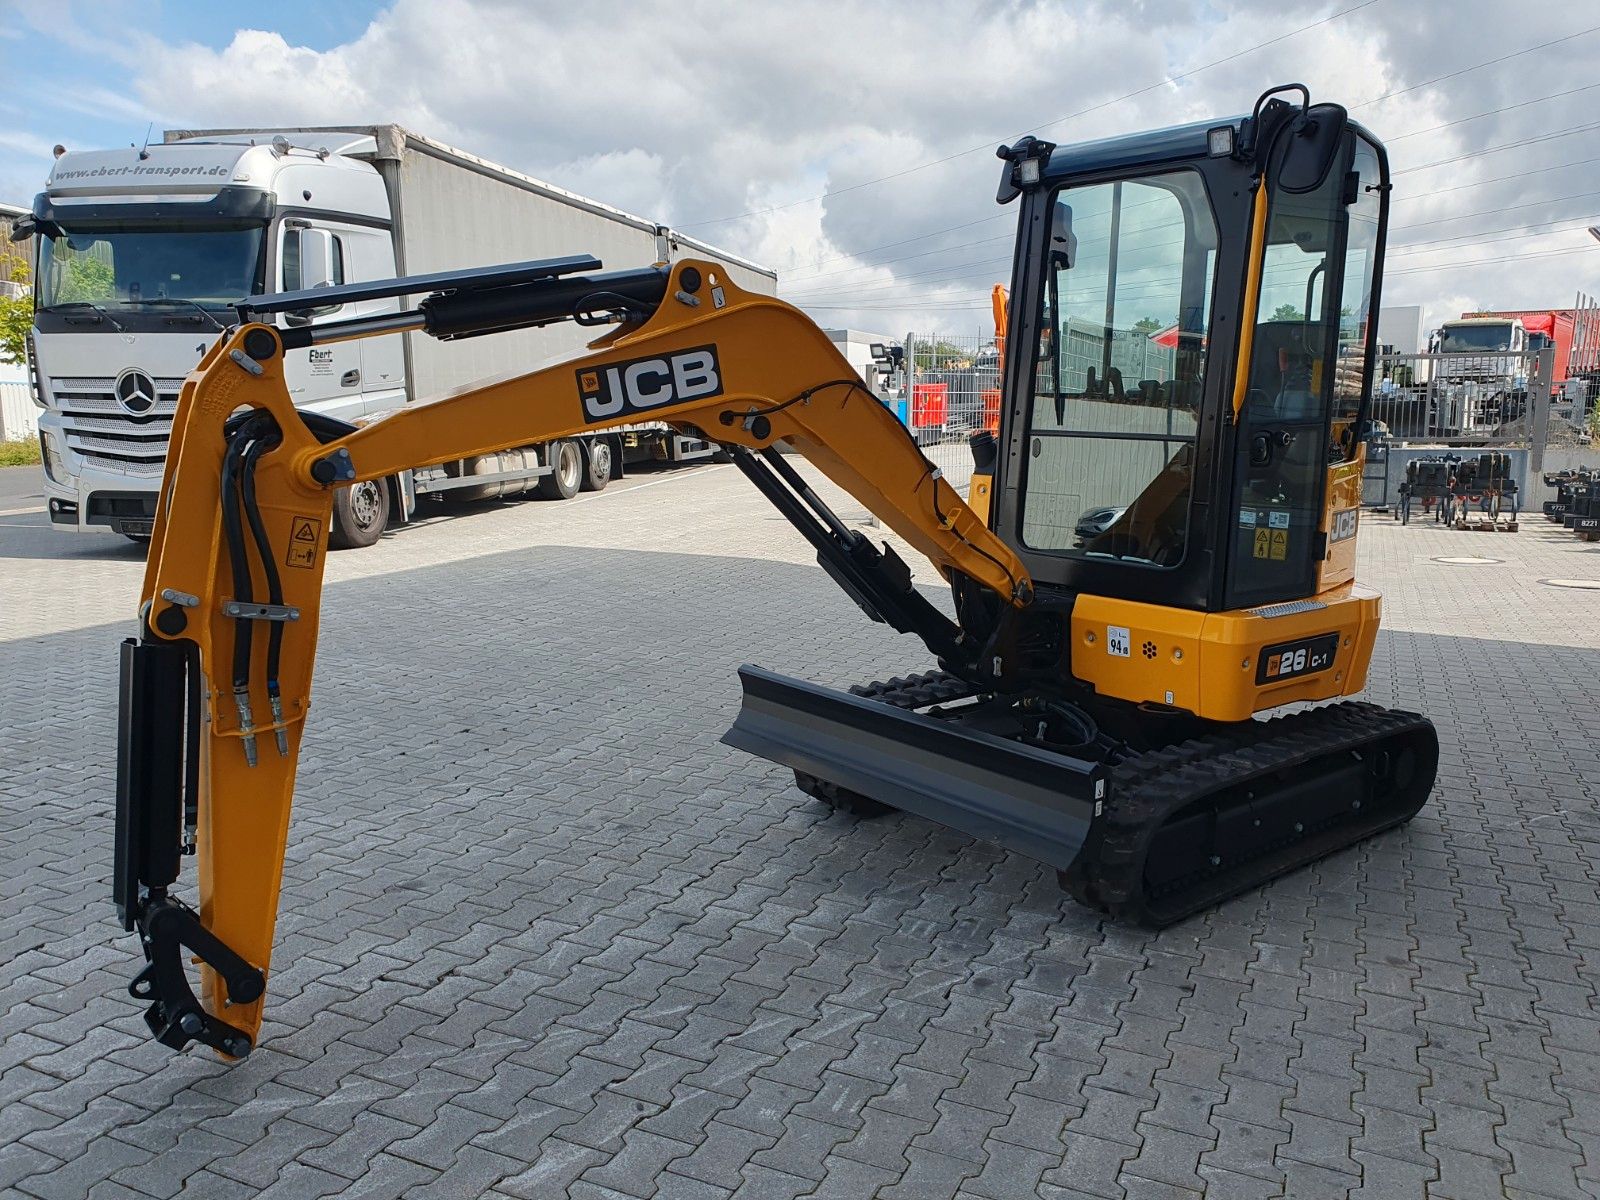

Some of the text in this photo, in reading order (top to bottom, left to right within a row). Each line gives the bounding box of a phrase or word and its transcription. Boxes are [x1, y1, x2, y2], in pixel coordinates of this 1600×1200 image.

[56, 165, 228, 181] www.ebert-transport.de
[309, 349, 333, 361] Ebert
[585, 351, 719, 416] JCB
[1331, 510, 1356, 540] JCB
[1111, 639, 1122, 653] 94
[1280, 648, 1306, 674] 26
[1312, 653, 1327, 667] C-1
